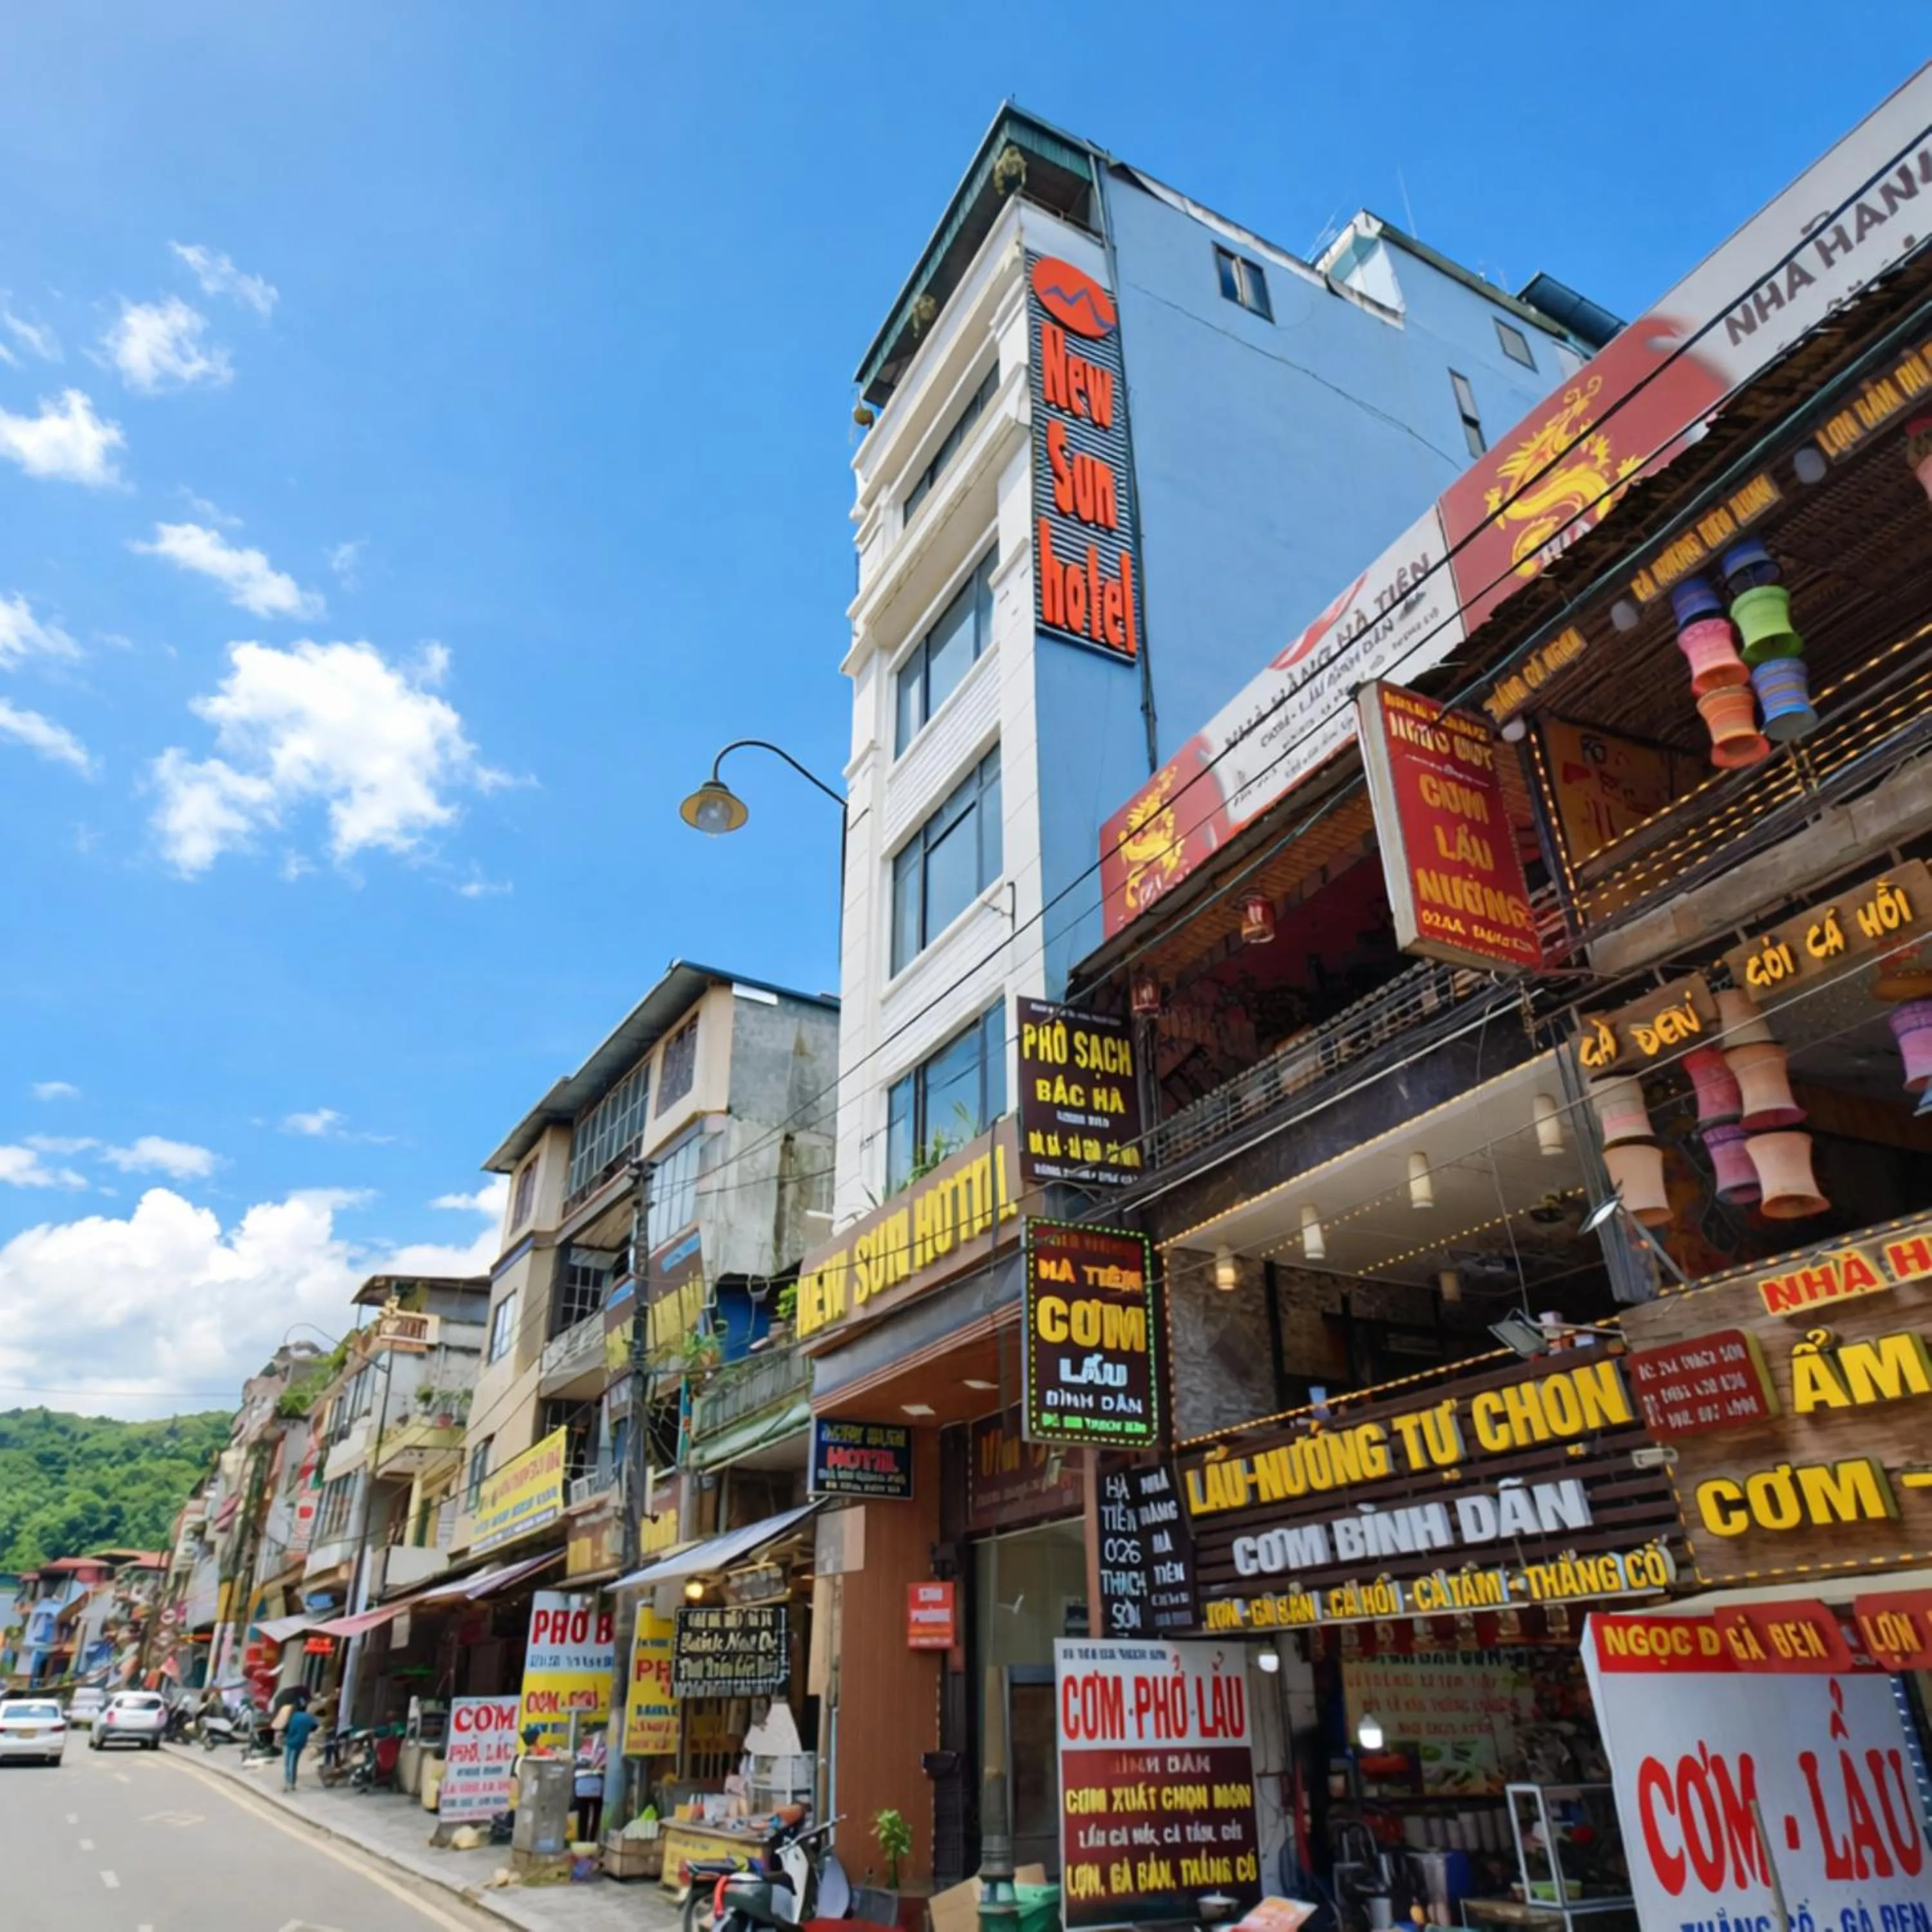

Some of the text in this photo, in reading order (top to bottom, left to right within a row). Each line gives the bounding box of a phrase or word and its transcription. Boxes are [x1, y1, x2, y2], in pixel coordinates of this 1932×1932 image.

[1040, 322, 1113, 430] New
[1046, 419, 1118, 531] Sun
[1037, 517, 1137, 657] hotel
[1806, 907, 1845, 958] CÁ
[1073, 1031, 1133, 1081] SẠCH
[1580, 1018, 1618, 1068] GÀ
[853, 1207, 910, 1306] SUN
[1036, 1295, 1146, 1352] CƠM
[1471, 1359, 1636, 1457] CHỌN
[1792, 1327, 1931, 1414] ẨM
[1233, 1477, 1593, 1577] CƠM BÌNH DÂN
[1696, 1457, 1888, 1538] CƠM
[1602, 1623, 1694, 1667] NGỌC
[1725, 1615, 1766, 1662] GÀ
[1859, 1610, 1922, 1663] LỢN
[1061, 1669, 1126, 1741] CƠM
[1133, 1653, 1189, 1740] PHỞ
[1195, 1650, 1245, 1739] LẨU
[1113, 1752, 1160, 1774] ÌNH
[1638, 1676, 1923, 1897] CƠM LẨU
